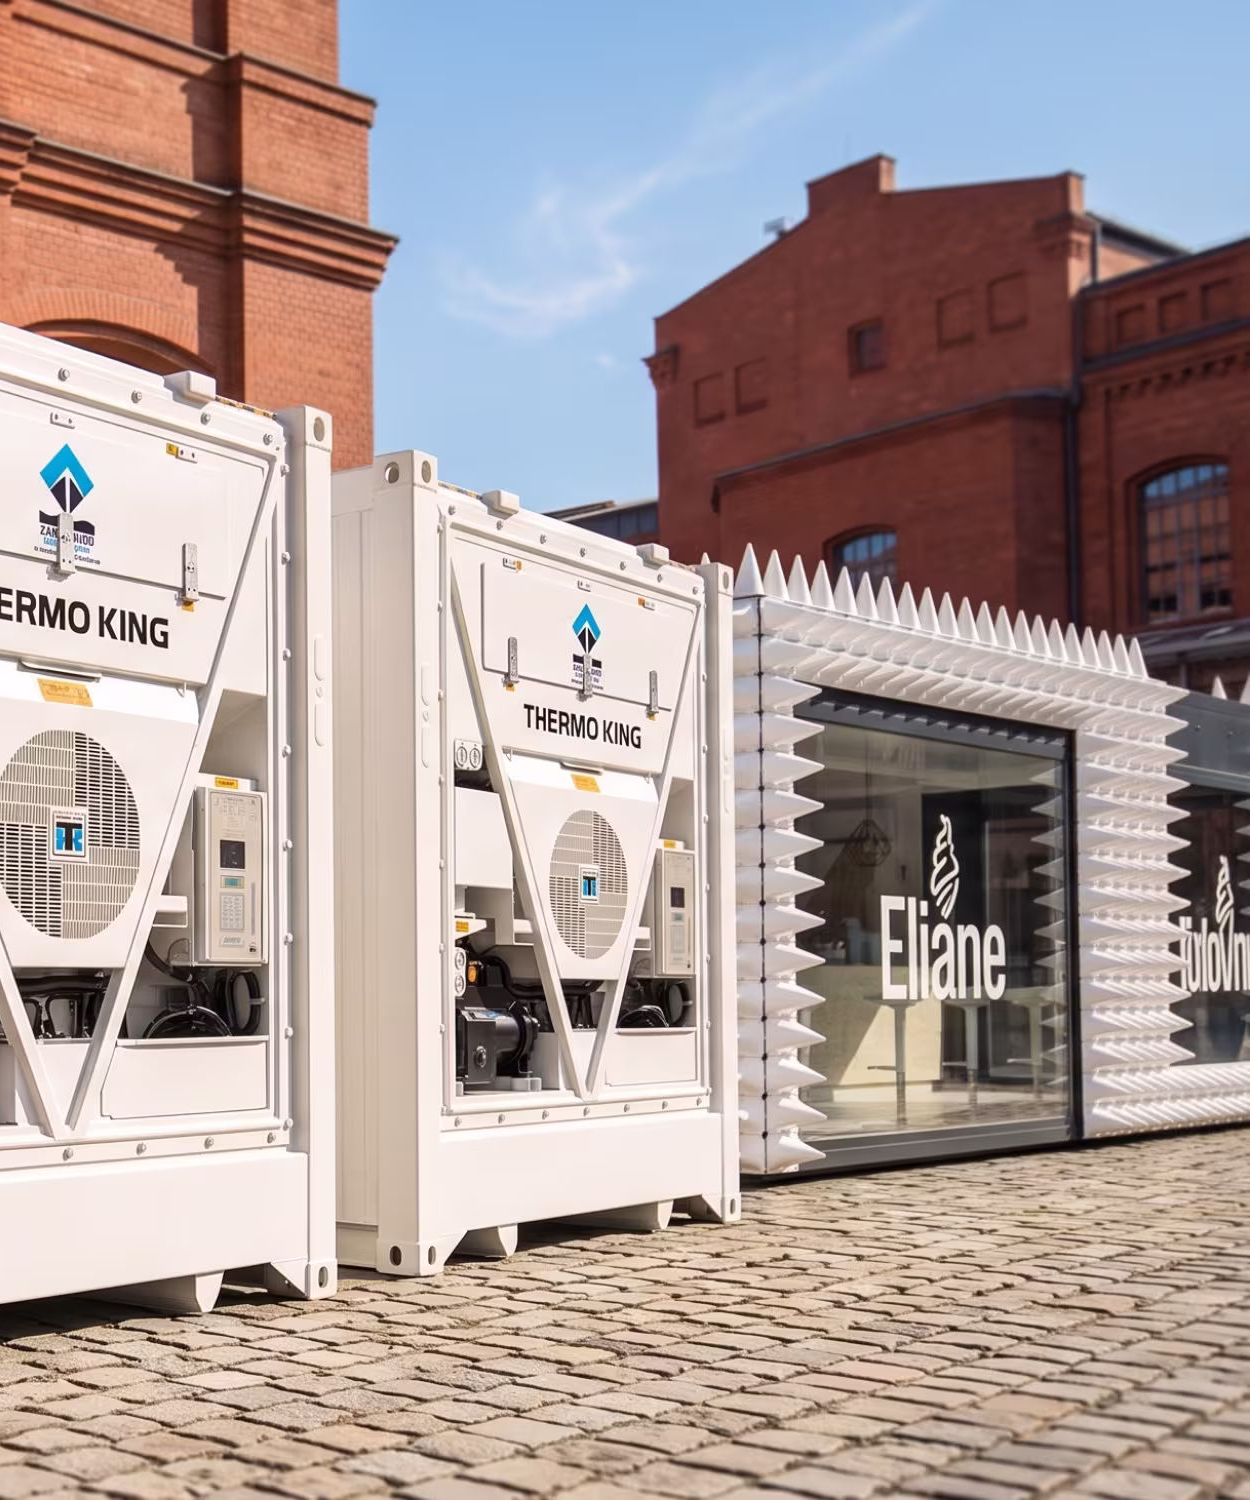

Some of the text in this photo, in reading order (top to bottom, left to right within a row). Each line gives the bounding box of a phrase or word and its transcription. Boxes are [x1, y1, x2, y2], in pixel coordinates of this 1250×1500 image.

[98, 605, 169, 650] KING
[523, 703, 642, 750] THERMO KING
[880, 894, 1007, 1001] Eliane
